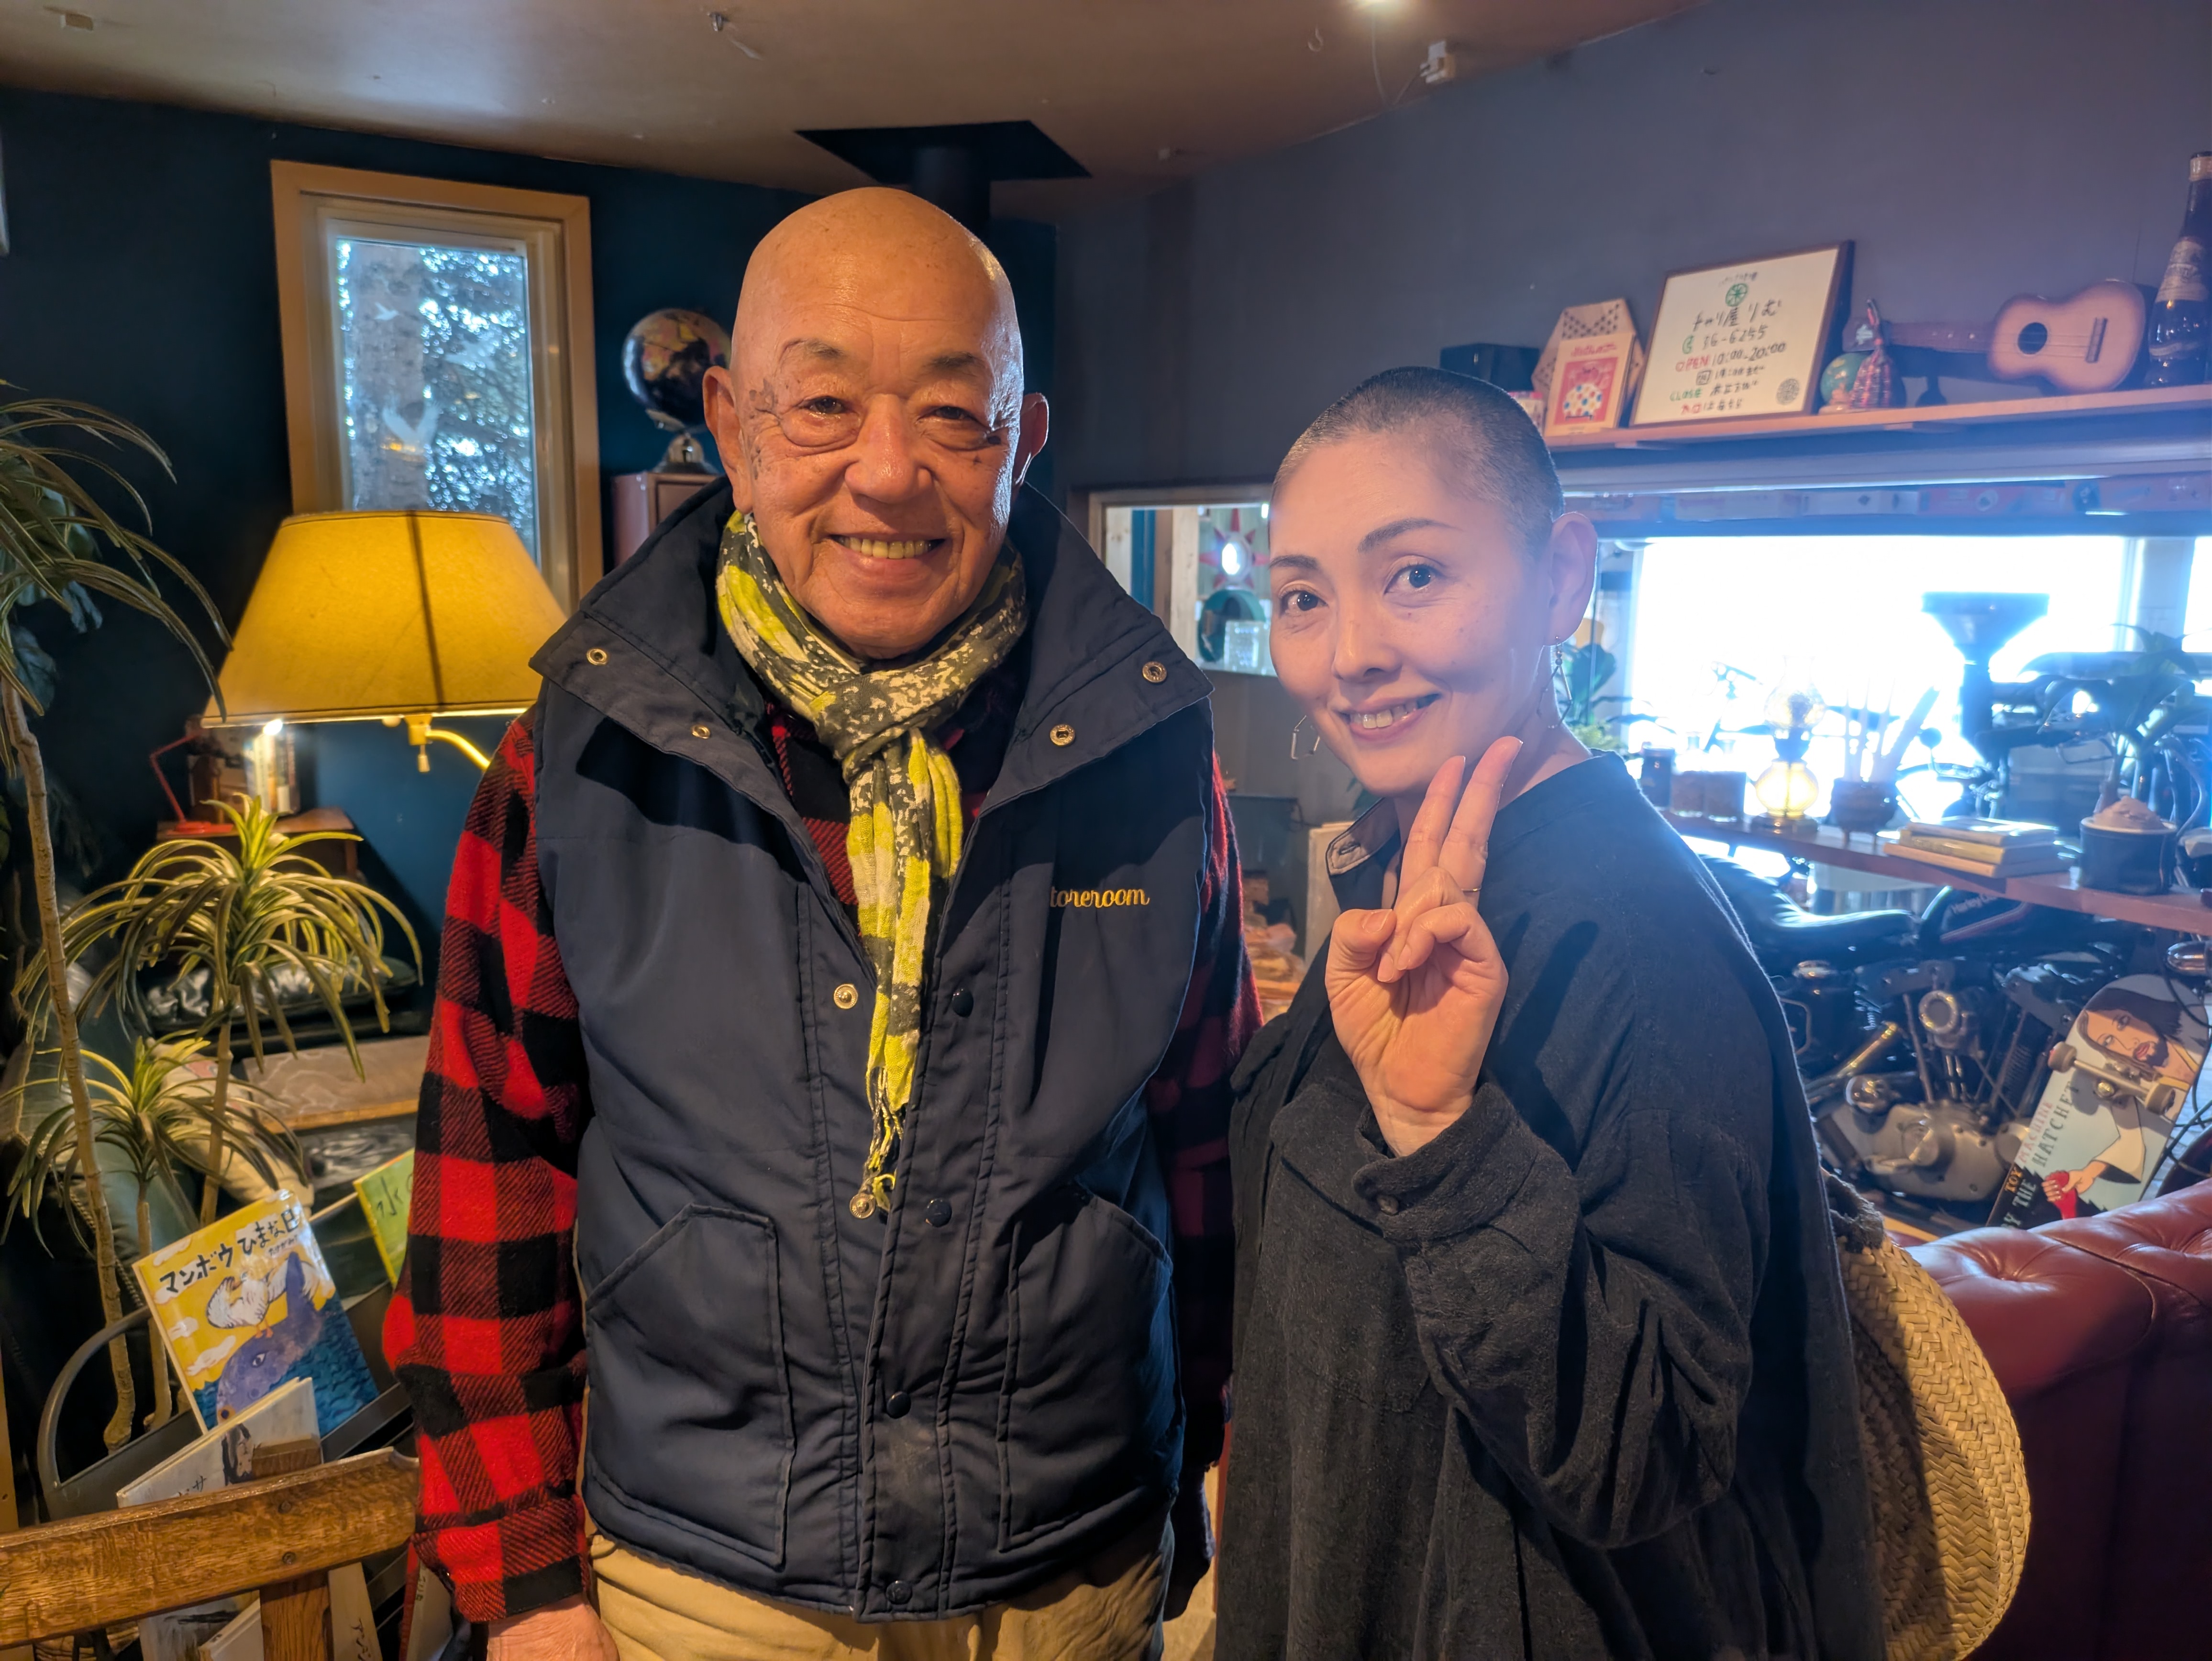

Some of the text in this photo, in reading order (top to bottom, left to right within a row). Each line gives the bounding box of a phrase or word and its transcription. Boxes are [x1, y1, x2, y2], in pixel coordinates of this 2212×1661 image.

[1675, 355, 1710, 372] OPEN
[1669, 388, 1702, 402] CLOSE
[1050, 886, 1150, 908] toreroom
[2004, 1101, 2053, 1193] TOY MACHINE
[2012, 1179, 2036, 1208] THE
[2032, 1080, 2079, 1168] HATCHET
[159, 1208, 300, 1293] マンボウ ひまな日
